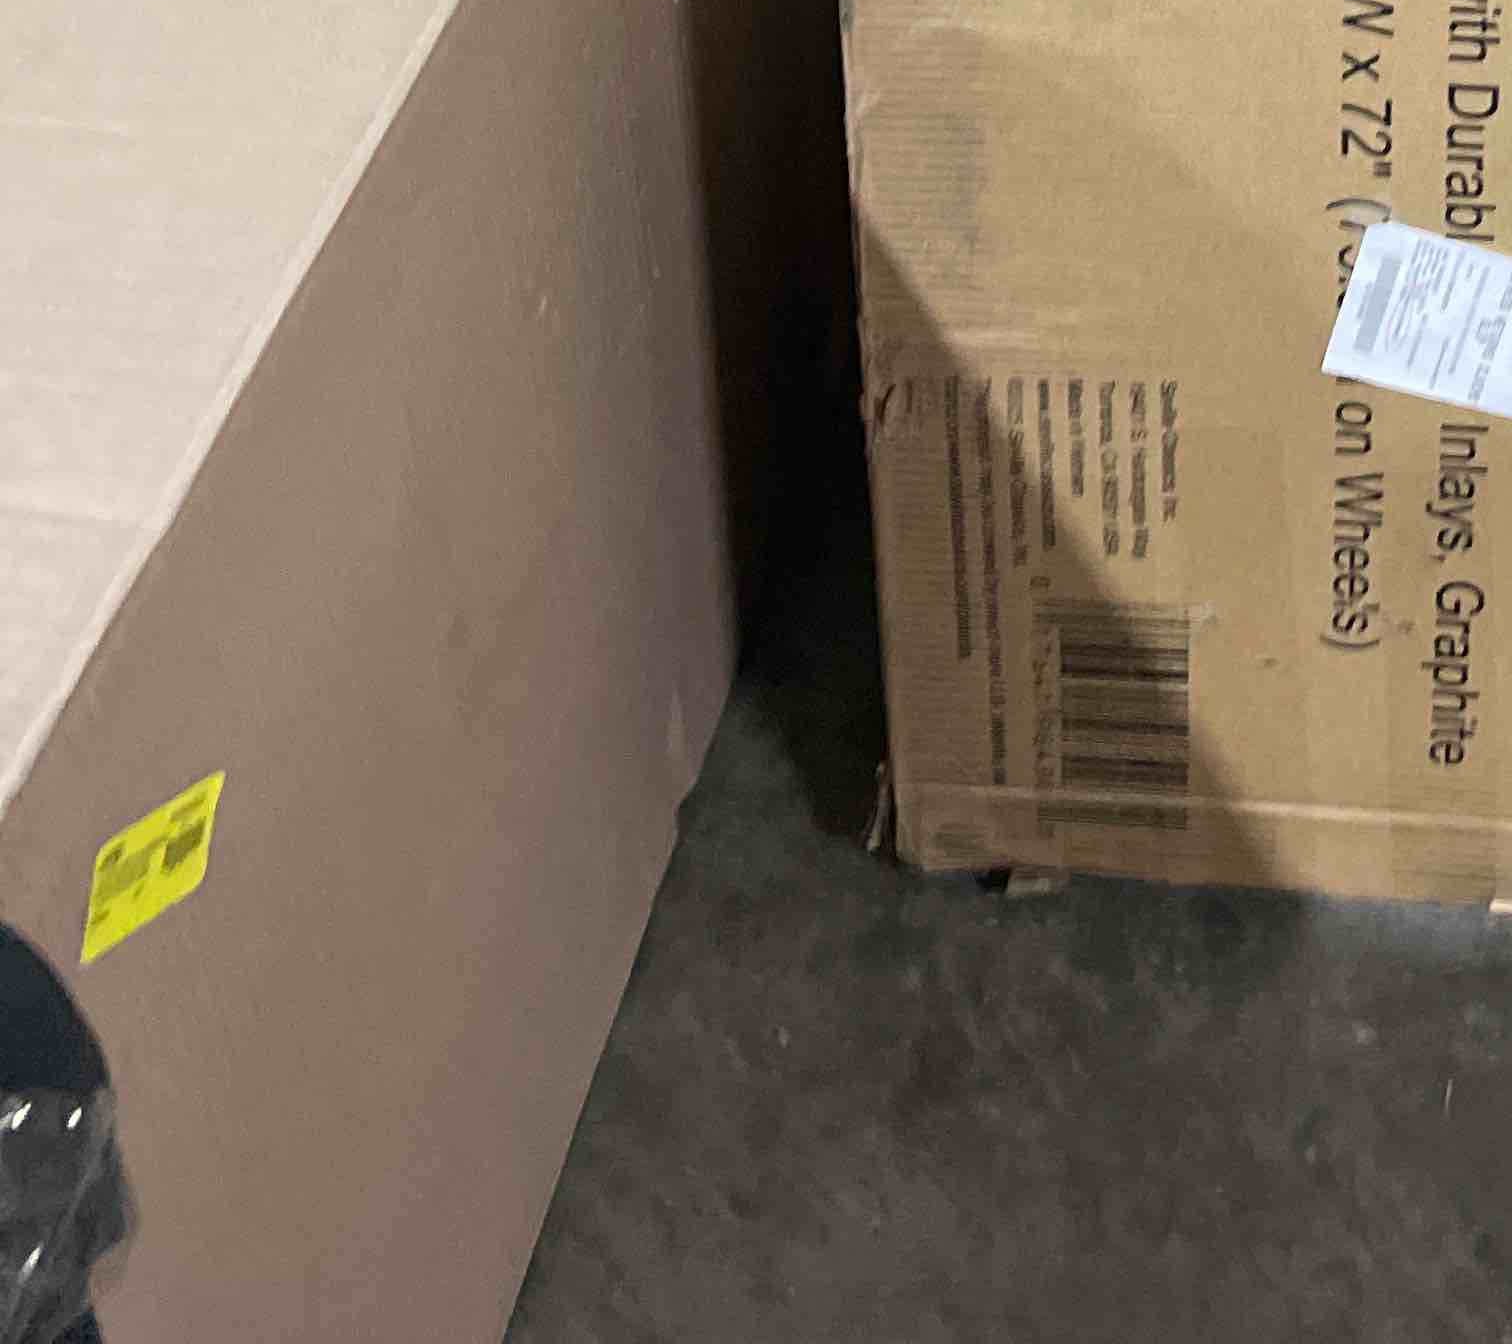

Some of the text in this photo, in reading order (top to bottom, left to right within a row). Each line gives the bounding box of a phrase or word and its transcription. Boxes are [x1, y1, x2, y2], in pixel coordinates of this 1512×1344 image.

[1340, 50, 1382, 84] x
[1443, 81, 1501, 243] Durabl
[1333, 400, 1374, 456] on
[1424, 422, 1490, 564] Inlays,
[1420, 580, 1486, 767] Graphite
